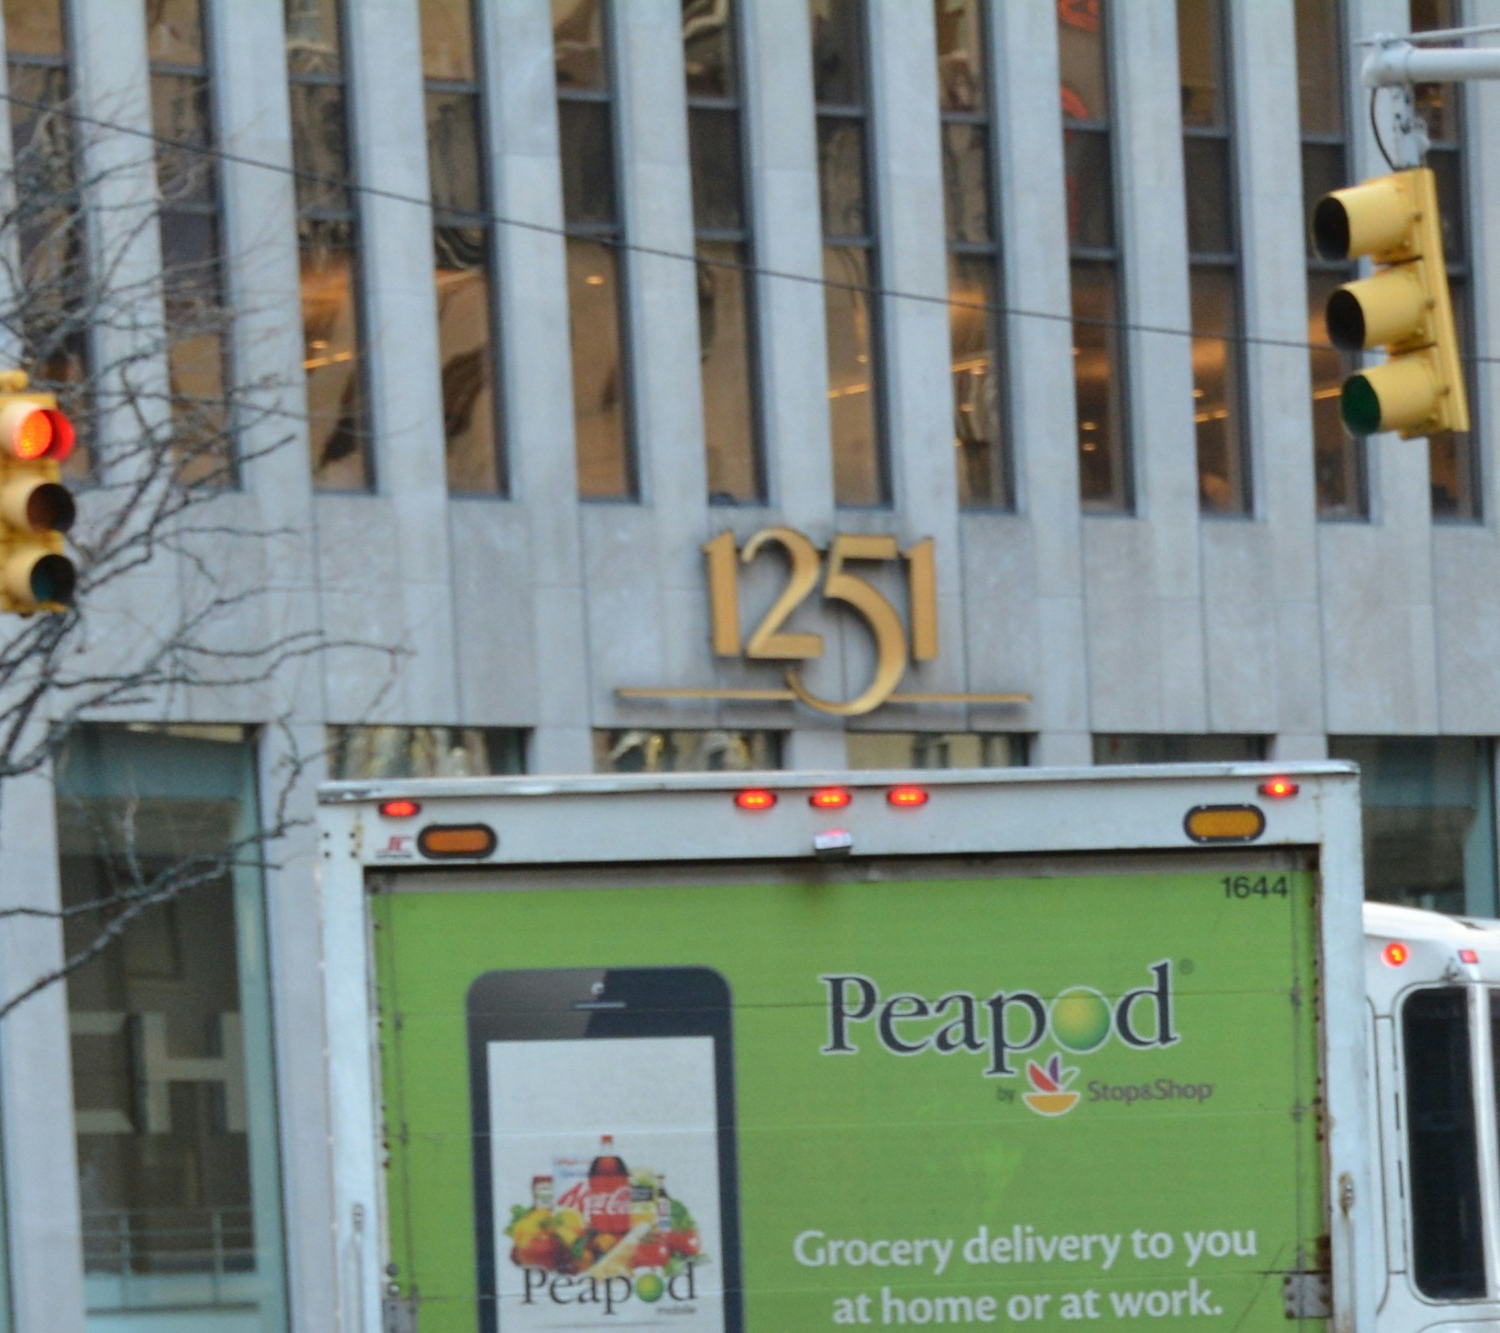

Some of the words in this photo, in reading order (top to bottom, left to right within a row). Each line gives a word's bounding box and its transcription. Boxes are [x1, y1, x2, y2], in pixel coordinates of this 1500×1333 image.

[703, 527, 937, 716] 1251
[1221, 876, 1288, 898] 1644
[820, 960, 1179, 1076] Peapod
[794, 1230, 953, 1274] Grocery
[963, 1225, 1121, 1269] delivery
[1132, 1229, 1173, 1260] to
[1184, 1229, 1258, 1266] you
[522, 1261, 697, 1315] Peapod
[832, 1293, 871, 1324] at
[883, 1286, 996, 1325] home
[1007, 1294, 1050, 1321] or
[1060, 1290, 1099, 1320] at
[1110, 1277, 1222, 1319] work.
